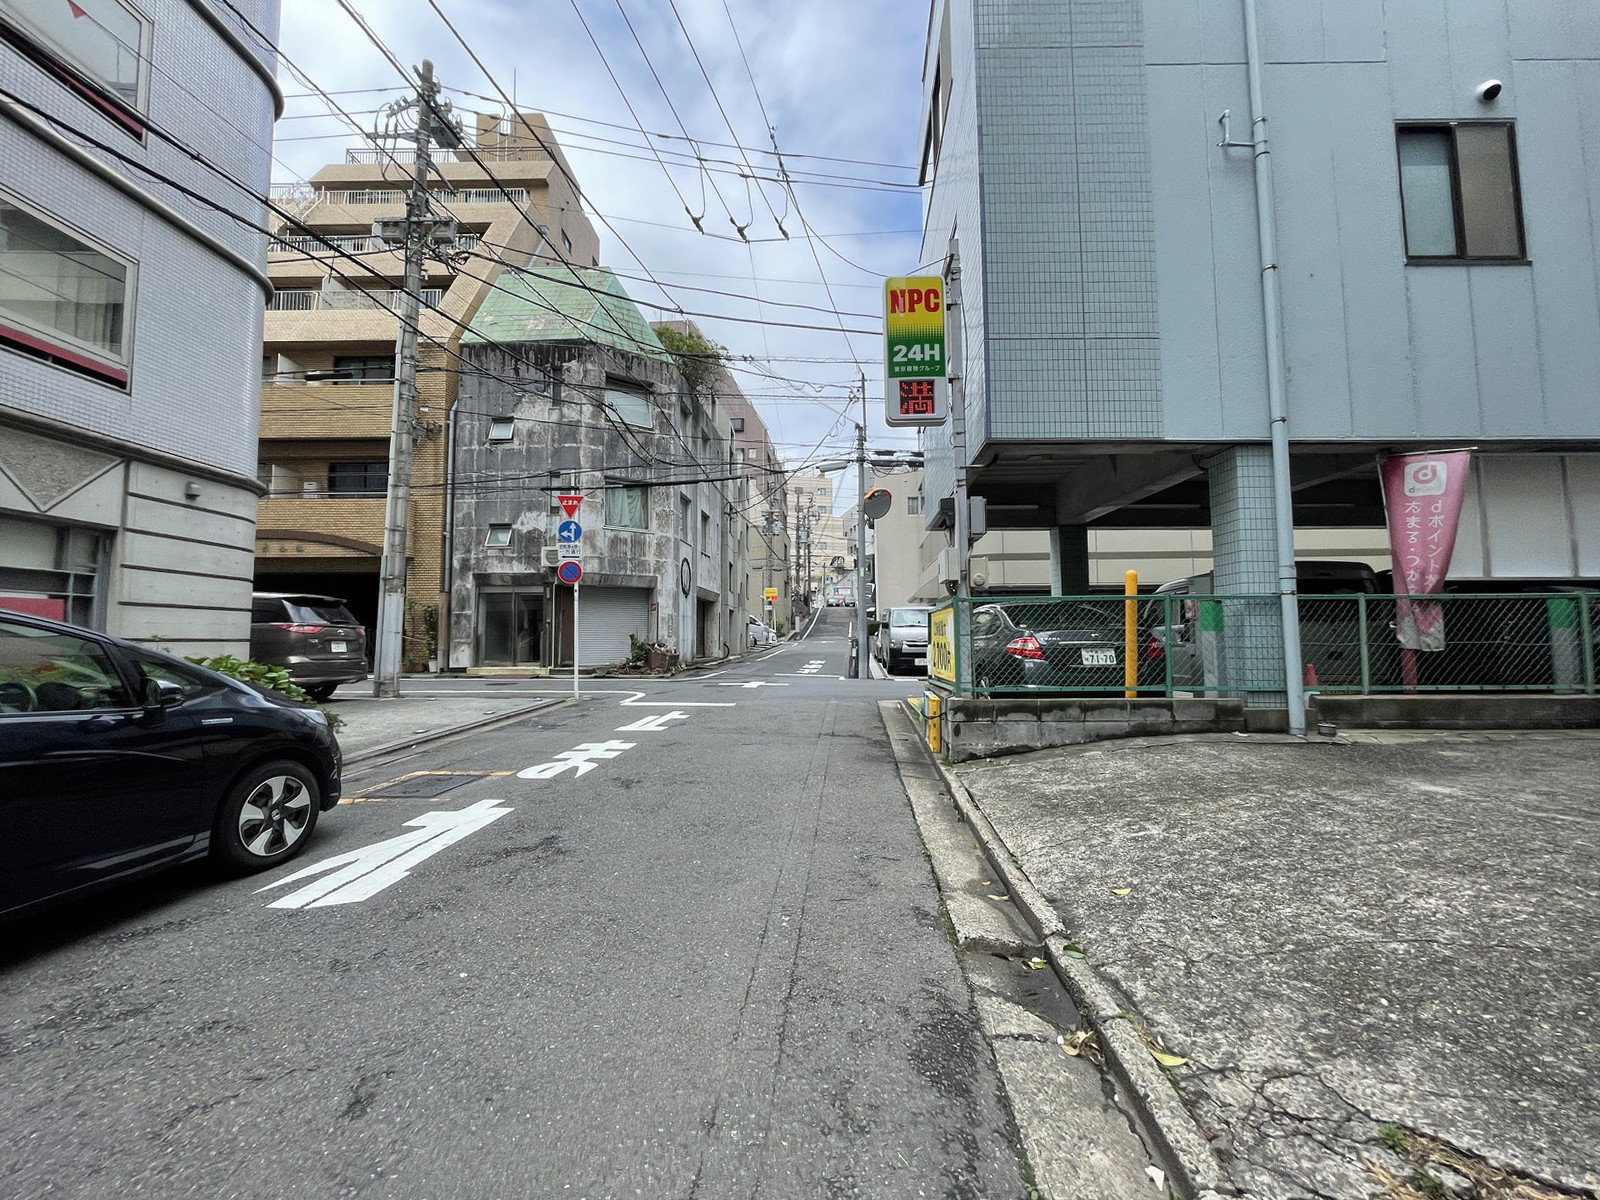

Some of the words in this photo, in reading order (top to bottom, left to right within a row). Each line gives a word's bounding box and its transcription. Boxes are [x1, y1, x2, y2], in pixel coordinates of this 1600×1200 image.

[890, 288, 940, 314] NPC
[893, 343, 940, 362] 24H
[899, 381, 934, 414] 満
[1424, 499, 1445, 586] dポイントが
[253, 710, 690, 909] 止まれ
